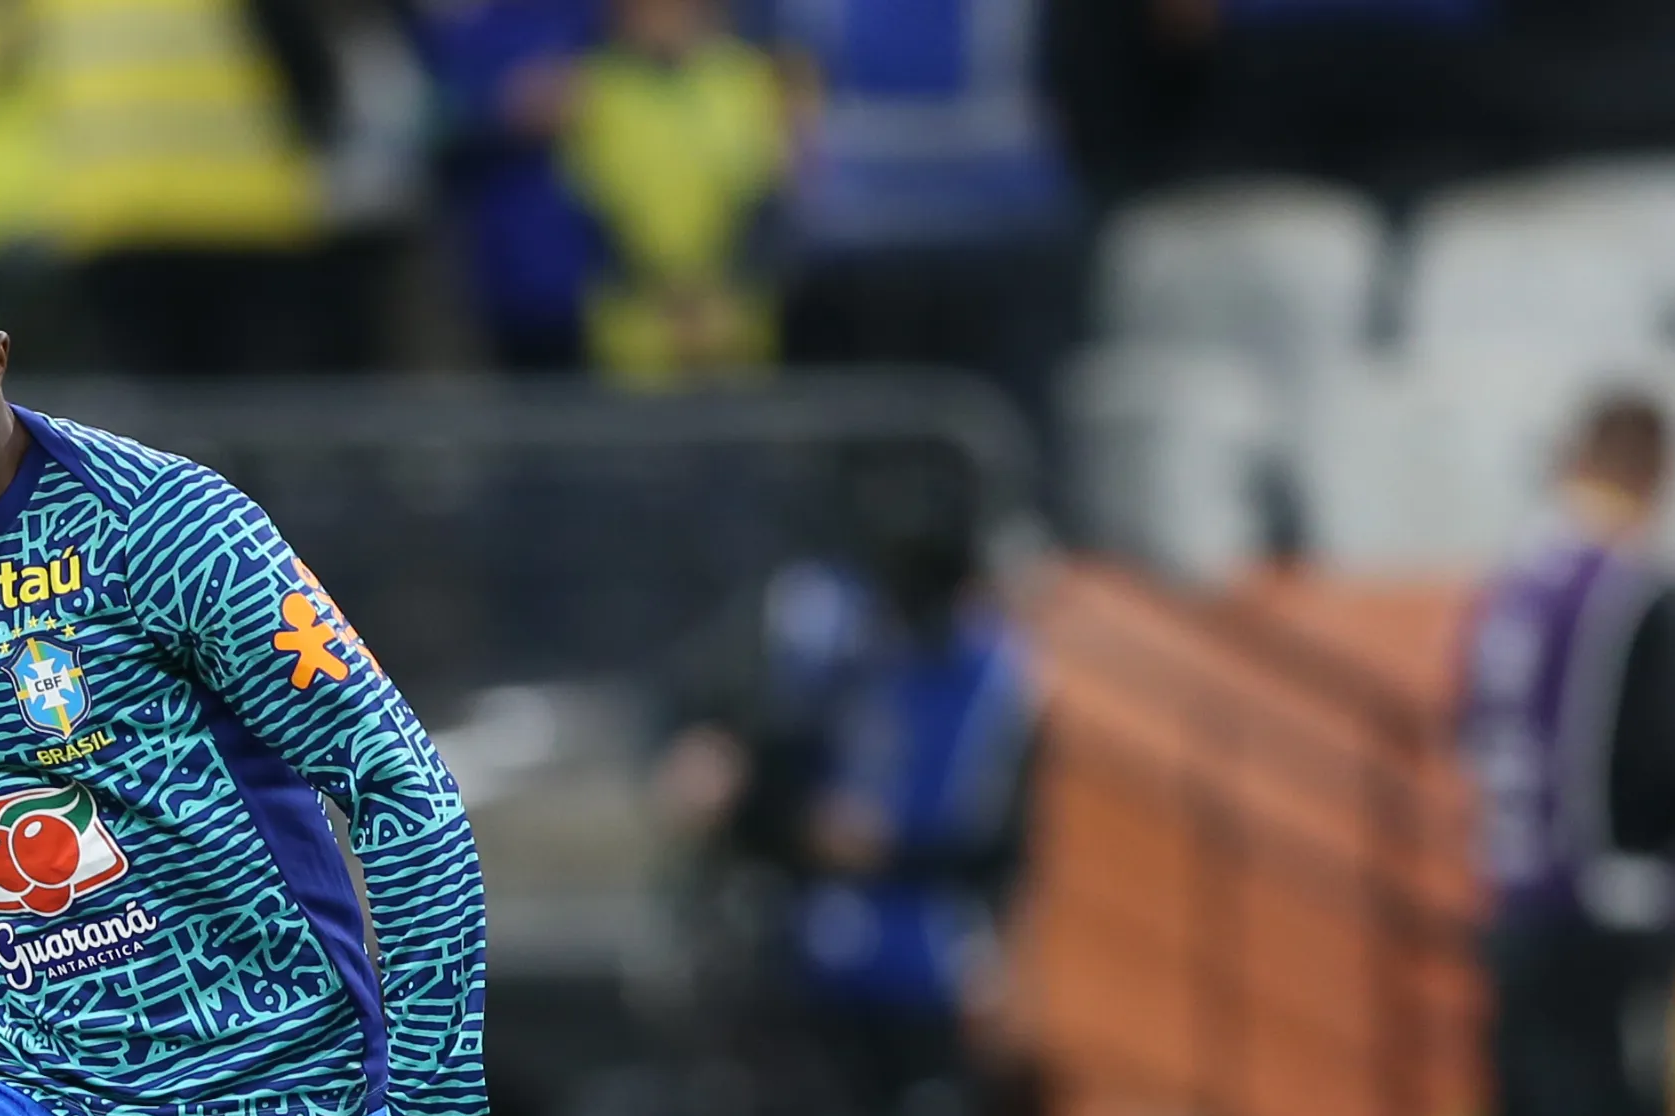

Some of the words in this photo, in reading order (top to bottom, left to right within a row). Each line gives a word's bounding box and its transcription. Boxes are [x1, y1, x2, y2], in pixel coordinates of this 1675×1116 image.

[34, 675, 62, 692] CBF
[36, 730, 113, 765] BRASIL
[47, 940, 145, 979] ANTARCTICA
